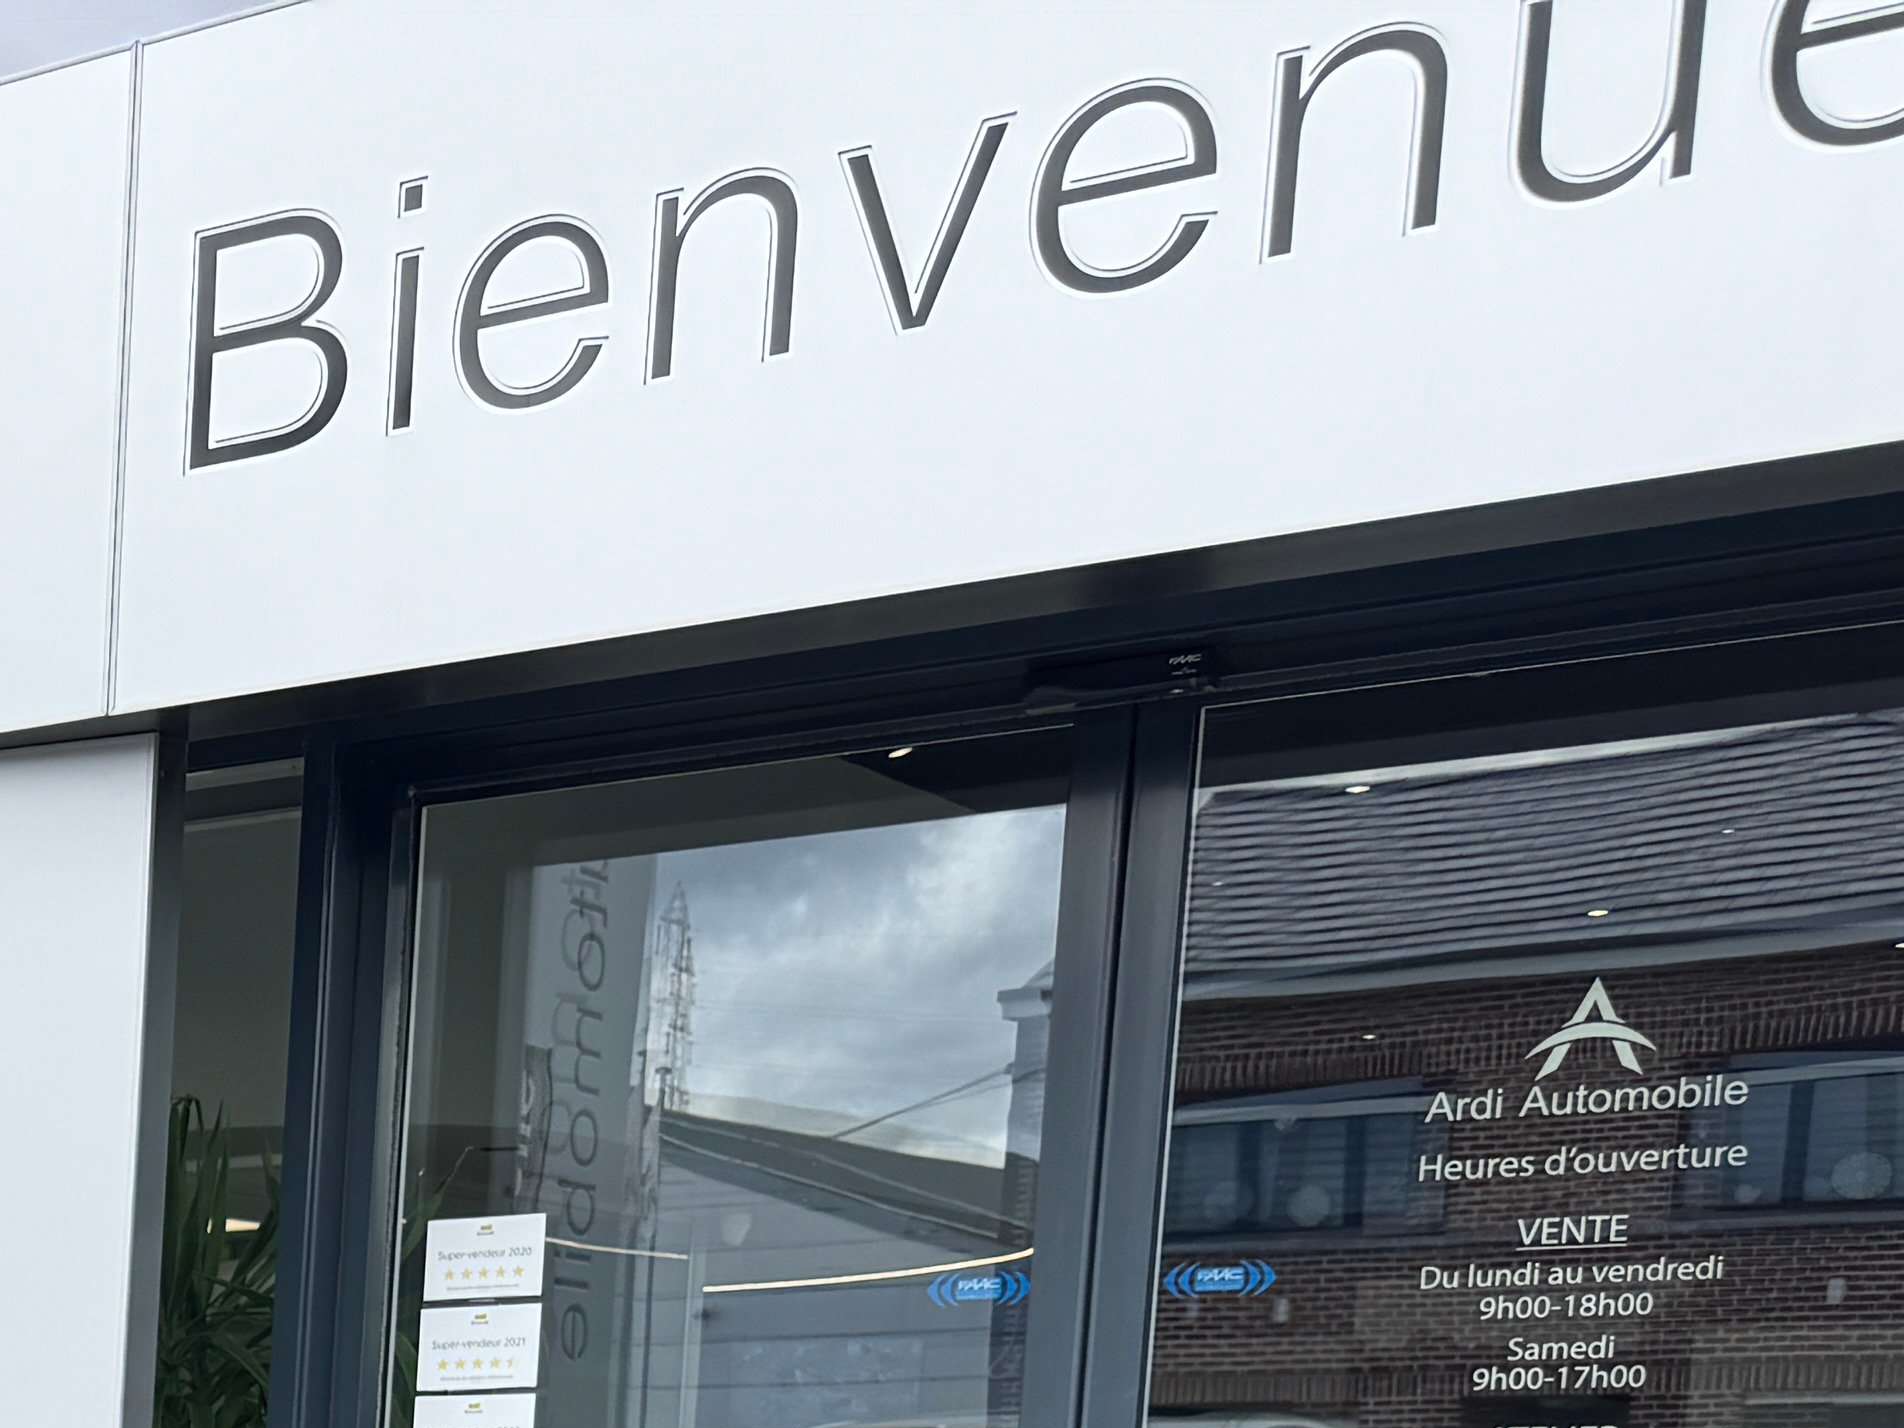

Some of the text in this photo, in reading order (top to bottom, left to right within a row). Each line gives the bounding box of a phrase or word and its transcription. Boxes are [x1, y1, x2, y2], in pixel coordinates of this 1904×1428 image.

[185, 0, 1904, 475] Bienvenue
[1424, 1075, 1750, 1123] Ardi Automobile
[1418, 1144, 1749, 1182] Heures d'ouverture
[1517, 1214, 1630, 1246] VENTE
[508, 1246, 533, 1259] 2020
[1420, 1255, 1724, 1290] Du lundi au vendredi
[1479, 1292, 1654, 1320] 9h00-18h00
[1506, 1334, 1616, 1361] Samedi
[1472, 1364, 1647, 1391] 9h00-17h00
